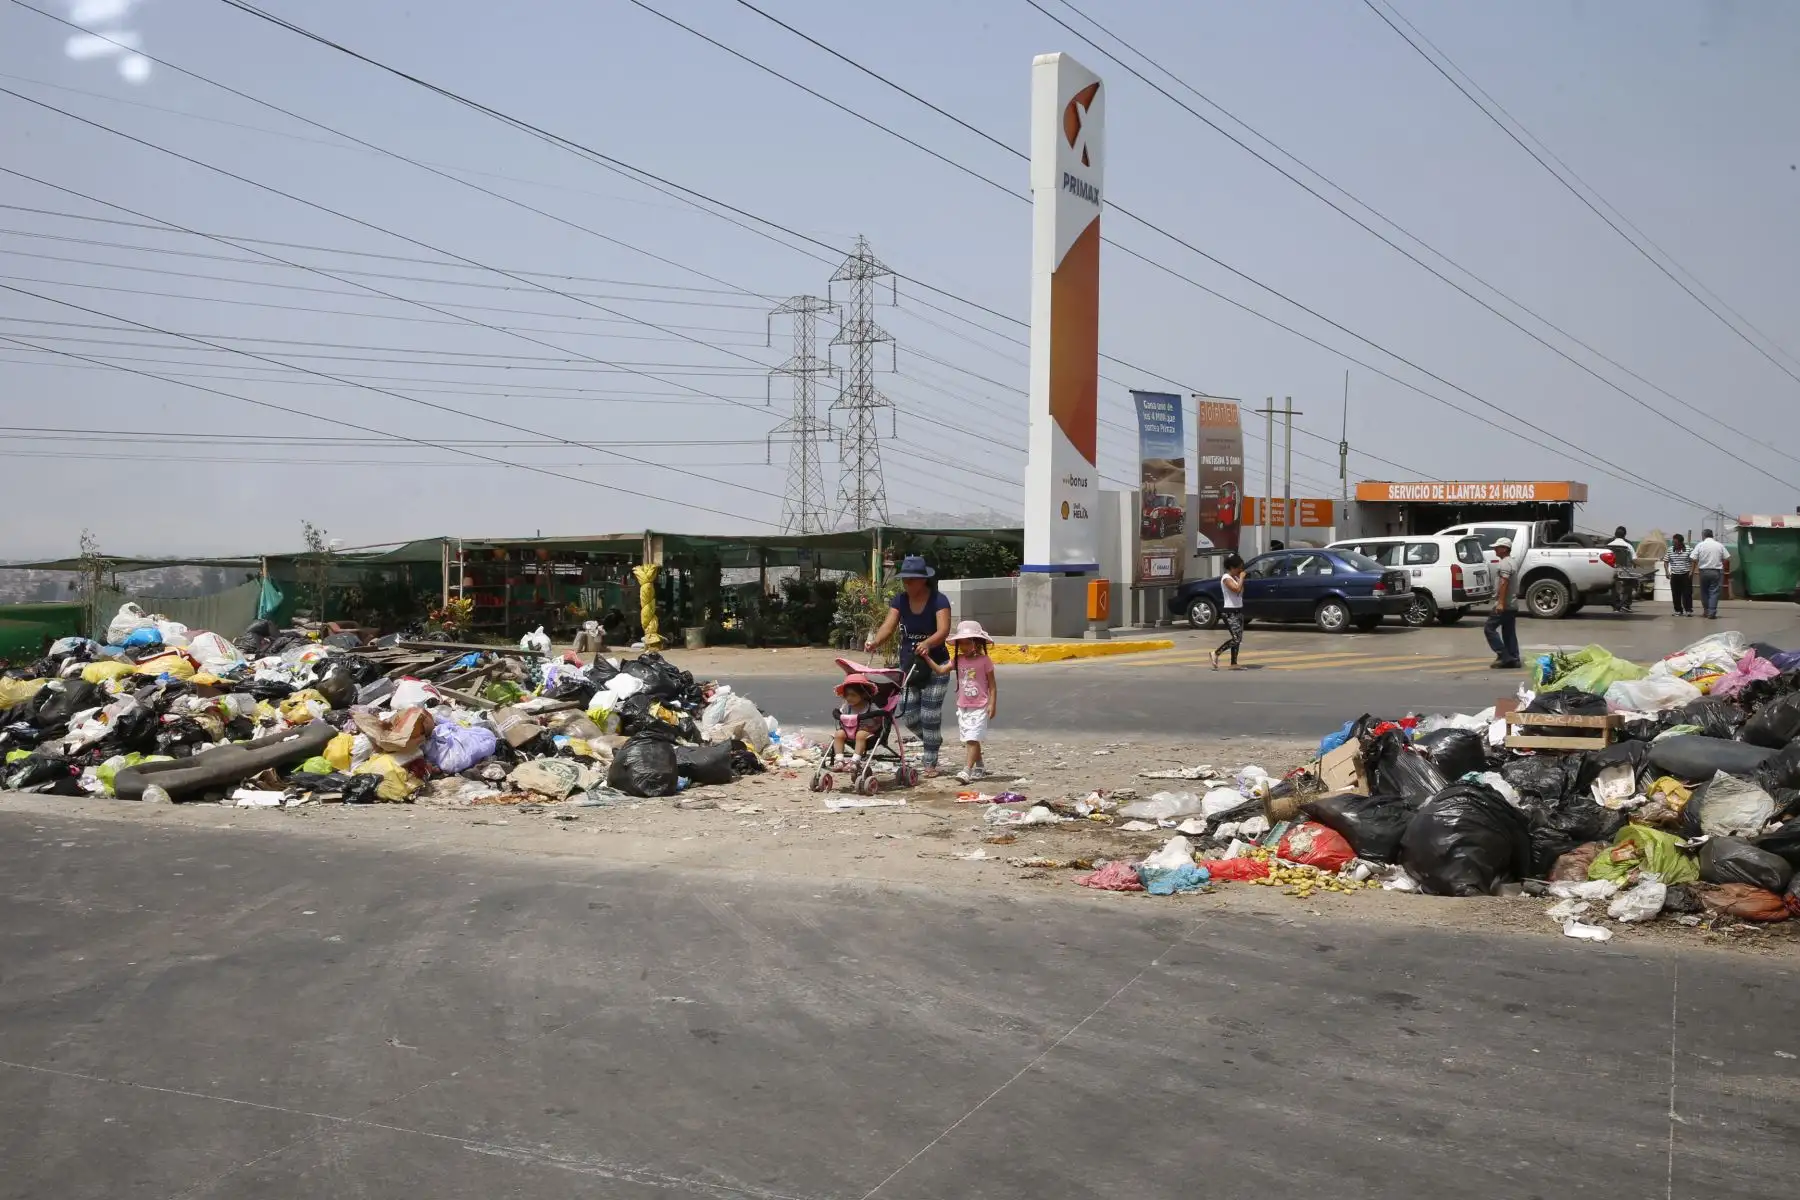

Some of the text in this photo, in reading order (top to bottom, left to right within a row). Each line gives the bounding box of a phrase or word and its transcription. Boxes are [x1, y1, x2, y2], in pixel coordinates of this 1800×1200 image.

[1063, 171, 1099, 206] PRIMAX
[1388, 485, 1535, 500] SERVICIO DE LLANTAS 24 HORAS
